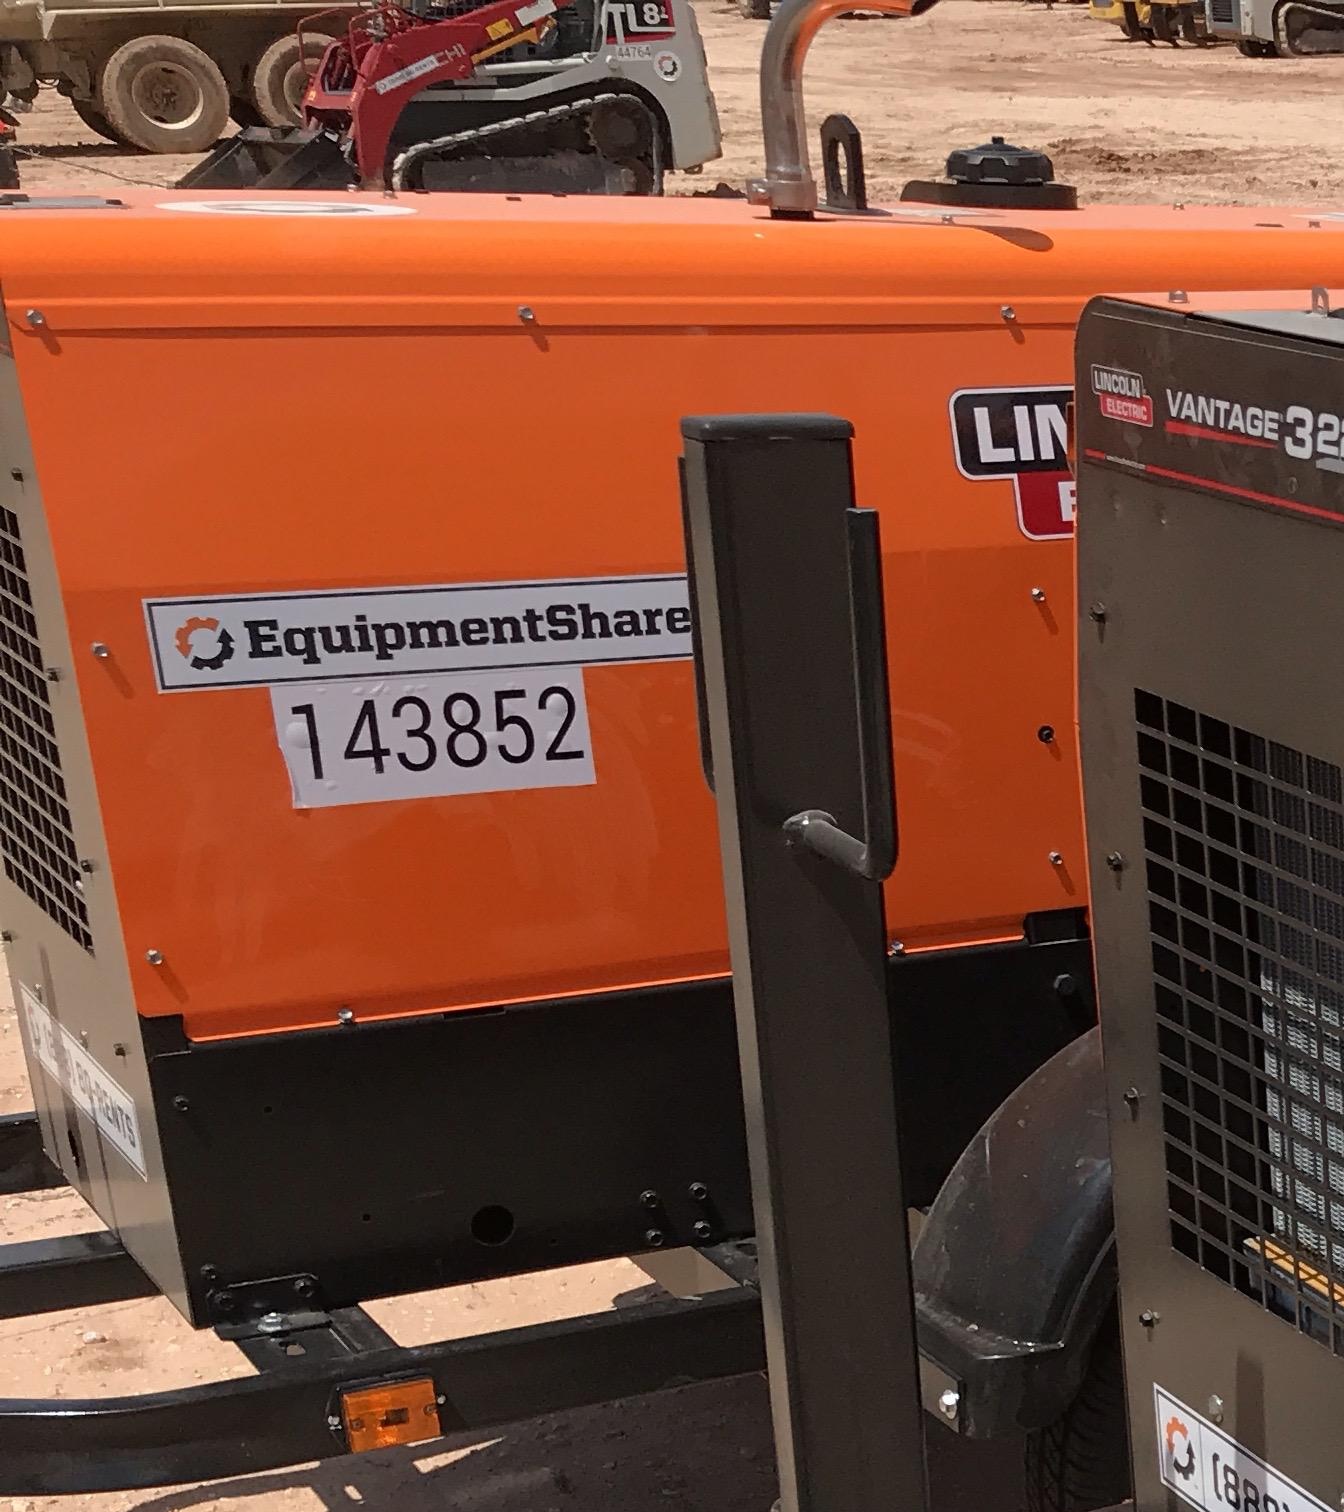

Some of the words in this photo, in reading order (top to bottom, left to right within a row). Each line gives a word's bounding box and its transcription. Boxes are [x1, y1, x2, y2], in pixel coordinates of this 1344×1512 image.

[1093, 369, 1141, 398] LINCOLN
[1106, 397, 1148, 421] ELECTRIC
[1166, 388, 1280, 441] VANTAGE
[244, 602, 691, 665] EquipmentShare
[291, 685, 585, 780] 143852
